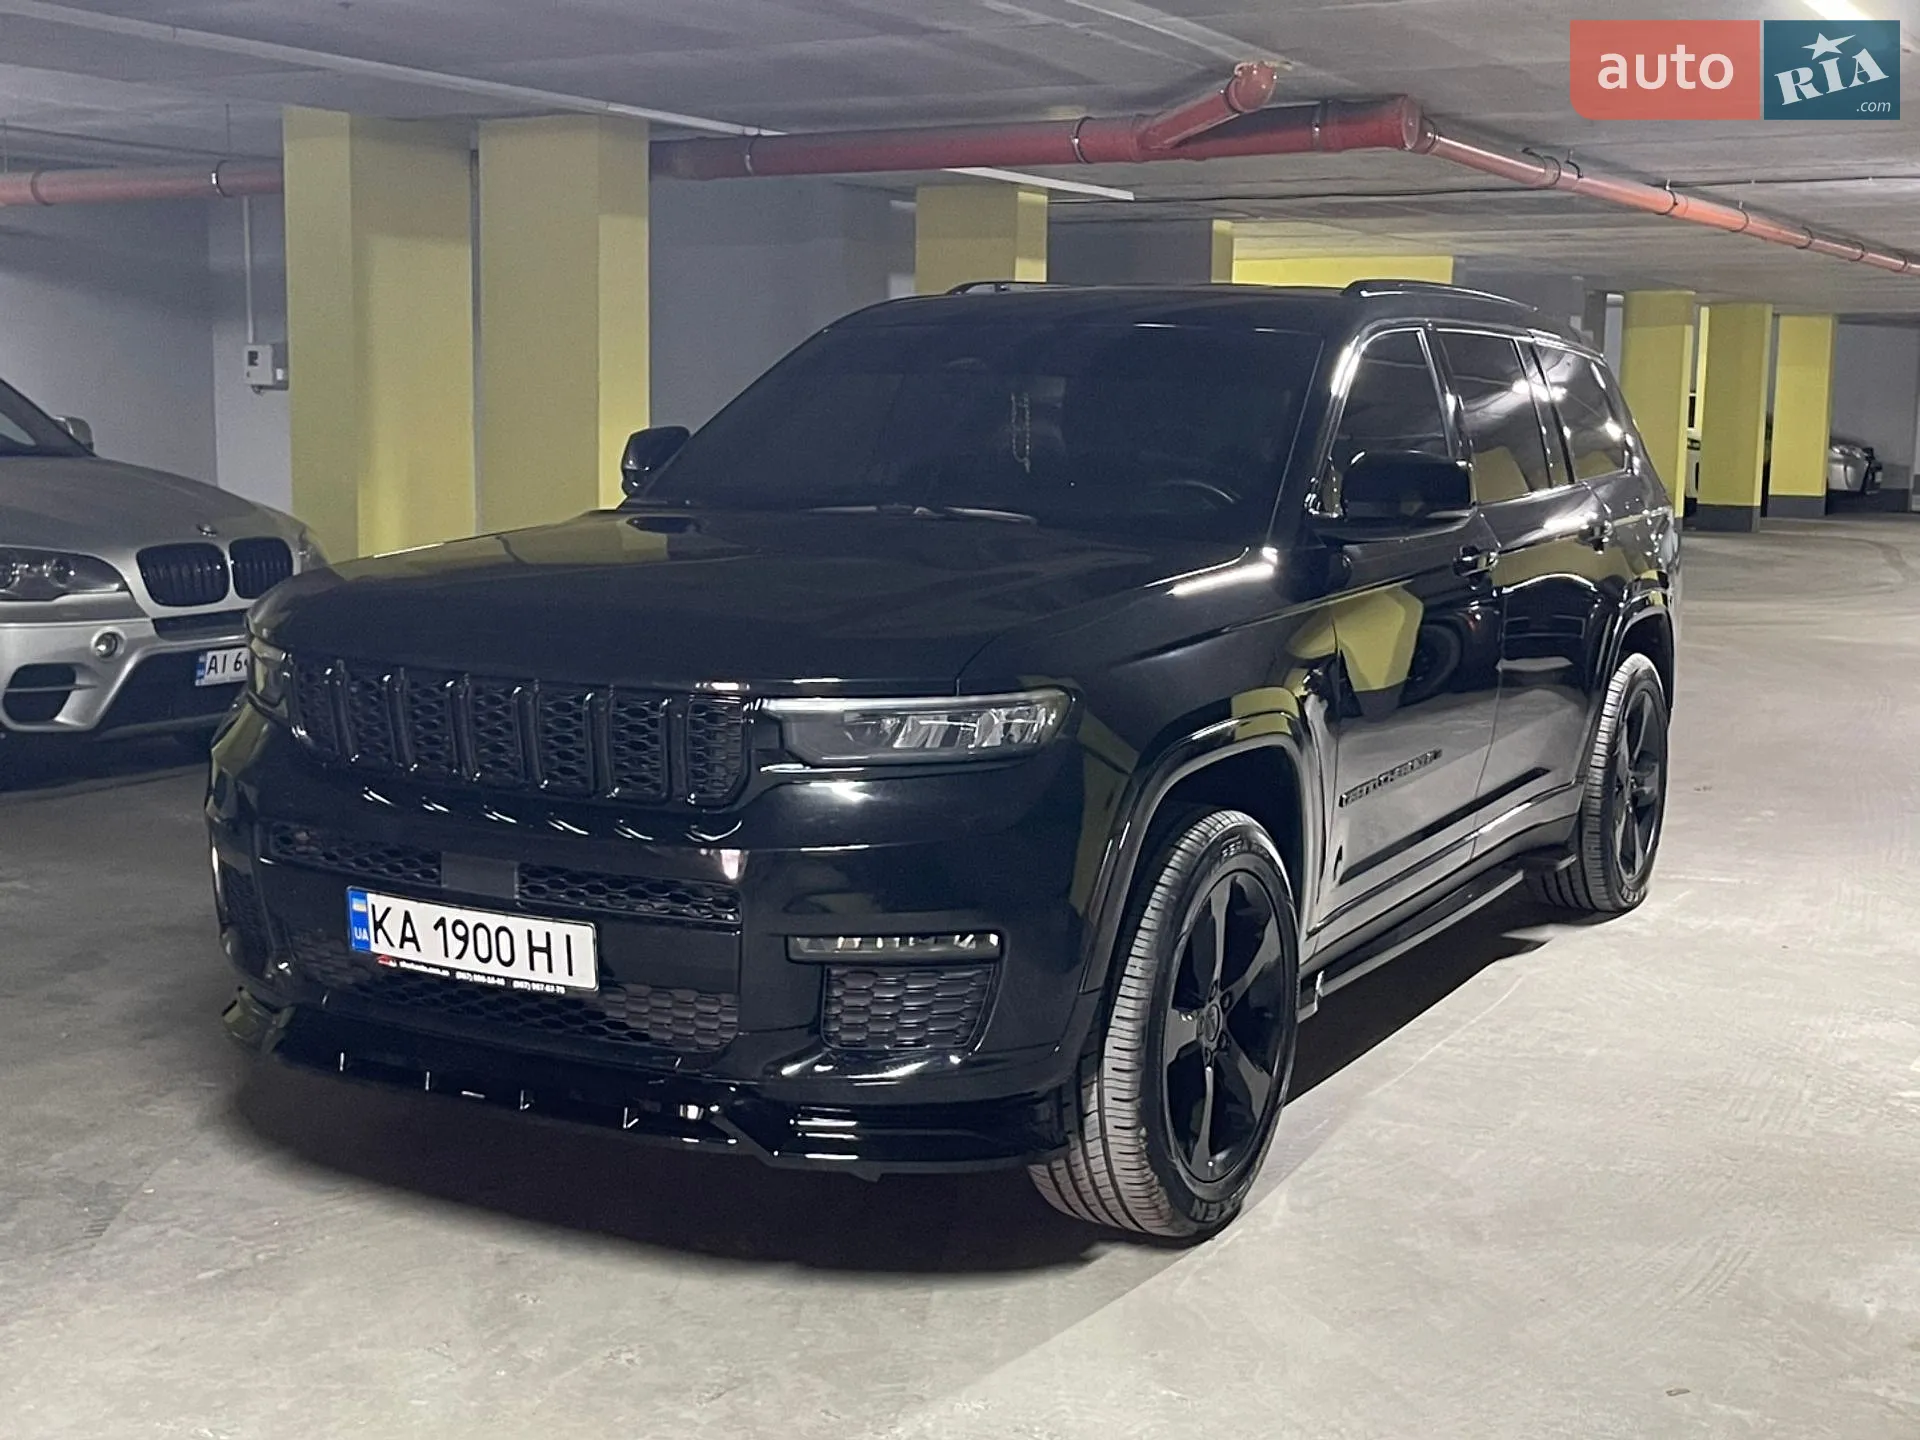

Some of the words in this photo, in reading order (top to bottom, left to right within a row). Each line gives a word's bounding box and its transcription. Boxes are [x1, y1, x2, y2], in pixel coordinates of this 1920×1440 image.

[206, 653, 228, 676] AI
[354, 925, 369, 941] UA
[371, 903, 422, 953] KA
[433, 916, 515, 967] 1900
[526, 928, 574, 977] HI
